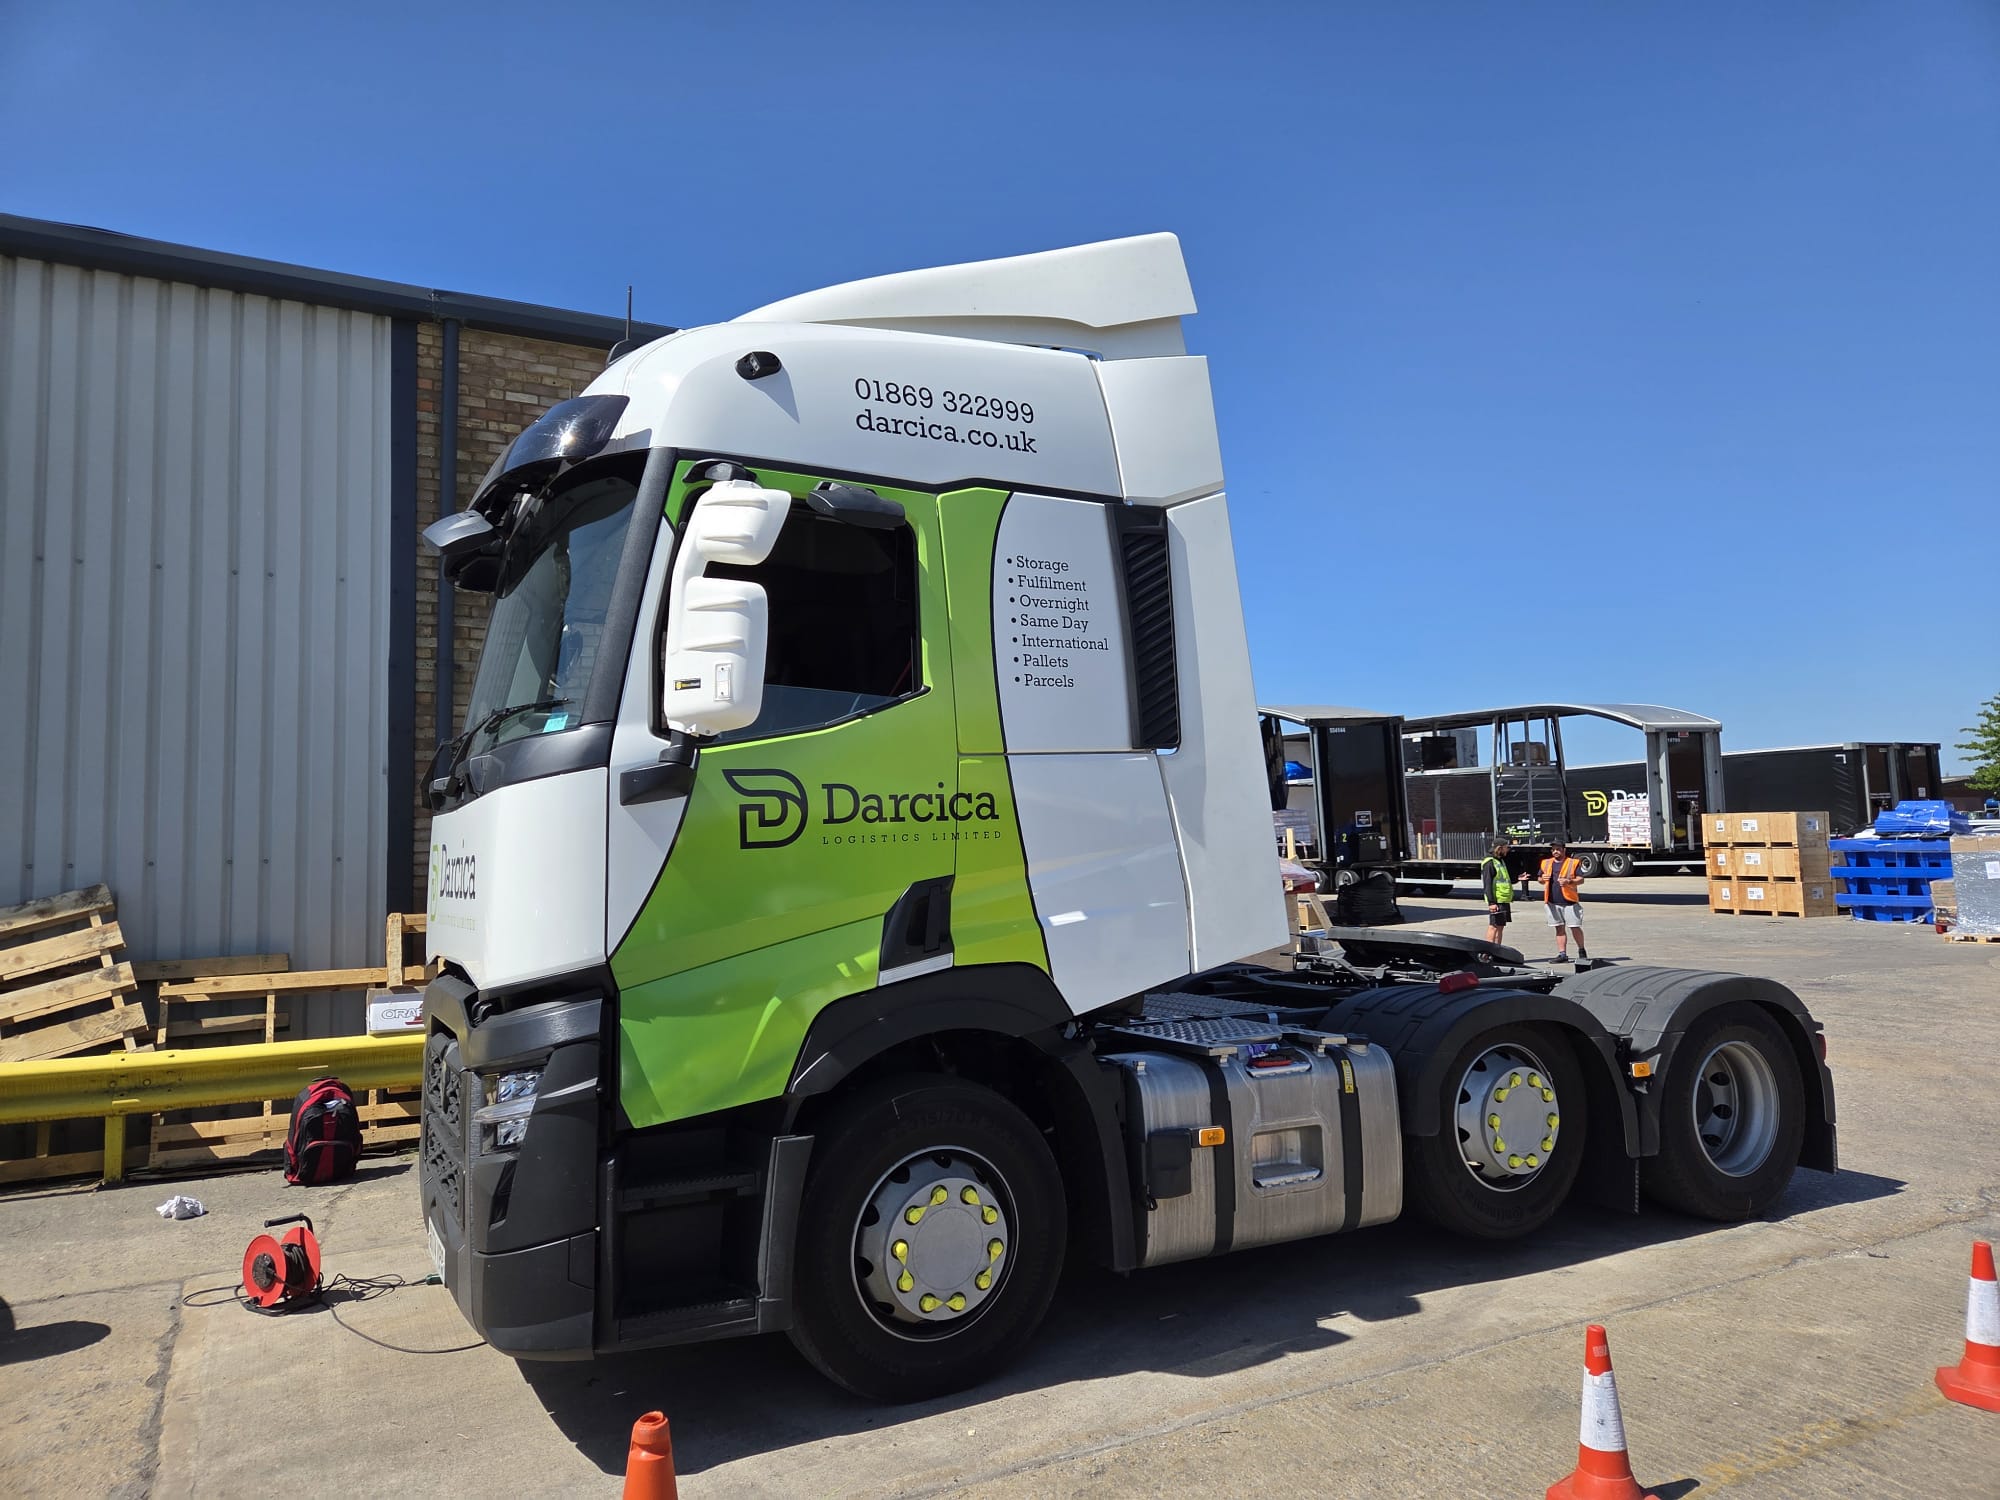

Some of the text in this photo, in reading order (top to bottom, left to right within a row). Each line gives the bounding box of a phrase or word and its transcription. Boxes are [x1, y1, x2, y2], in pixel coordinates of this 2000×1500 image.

[854, 377, 1035, 424] 01869 322999
[855, 408, 1037, 453] darcica.co.uk
[1016, 555, 1069, 574] Storage
[1017, 575, 1087, 591] Fulfilment
[1019, 594, 1090, 613] Overnight
[1020, 614, 1089, 633] Same Day
[1021, 634, 1109, 651] International
[1022, 653, 1069, 668] Pallets
[1024, 673, 1075, 688] Parcels
[821, 781, 1000, 825] Darcica
[823, 830, 1001, 845] LOGISTICS LIMITED
[439, 838, 476, 899] Darcica
